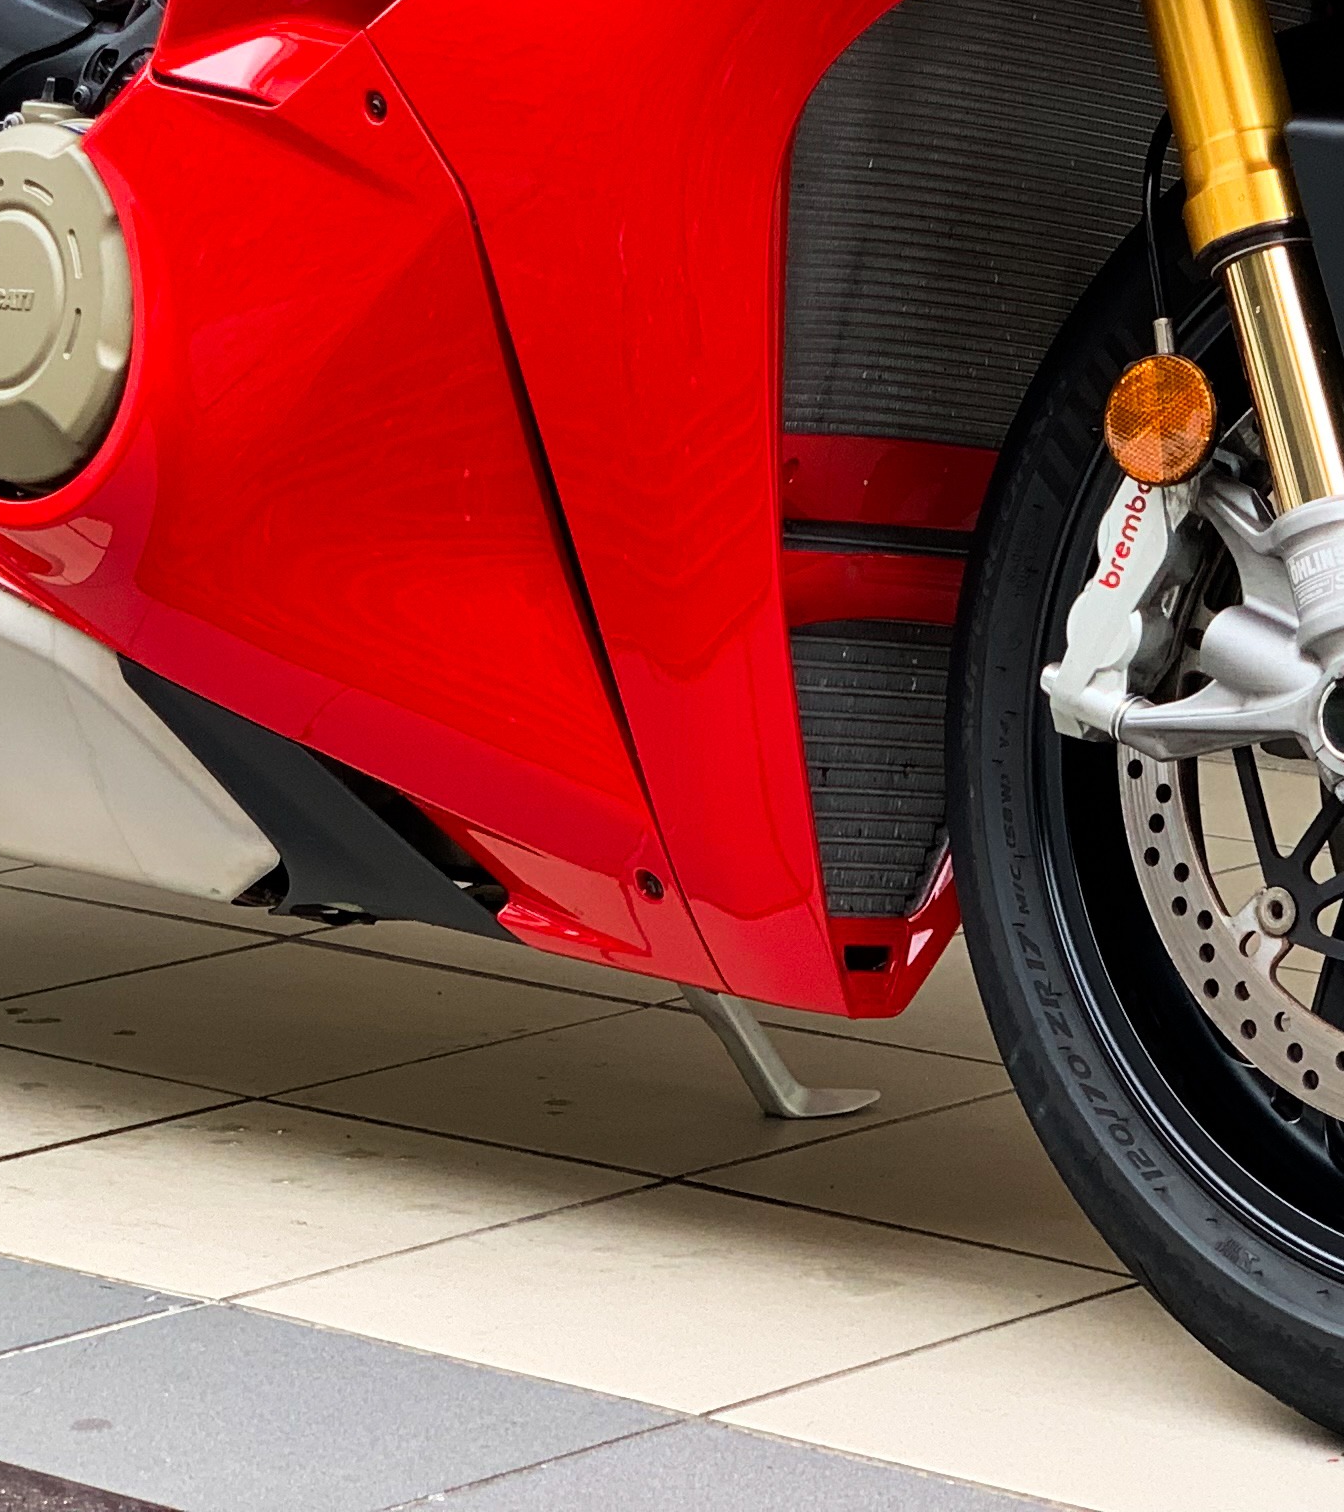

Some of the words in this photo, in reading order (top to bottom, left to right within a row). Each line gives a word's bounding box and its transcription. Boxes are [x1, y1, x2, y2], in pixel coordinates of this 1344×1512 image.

[1008, 866, 1031, 917] M/C
[1019, 928, 1048, 974] 17
[1033, 983, 1076, 1041] ZR
[1069, 1053, 1167, 1185] 120/70
